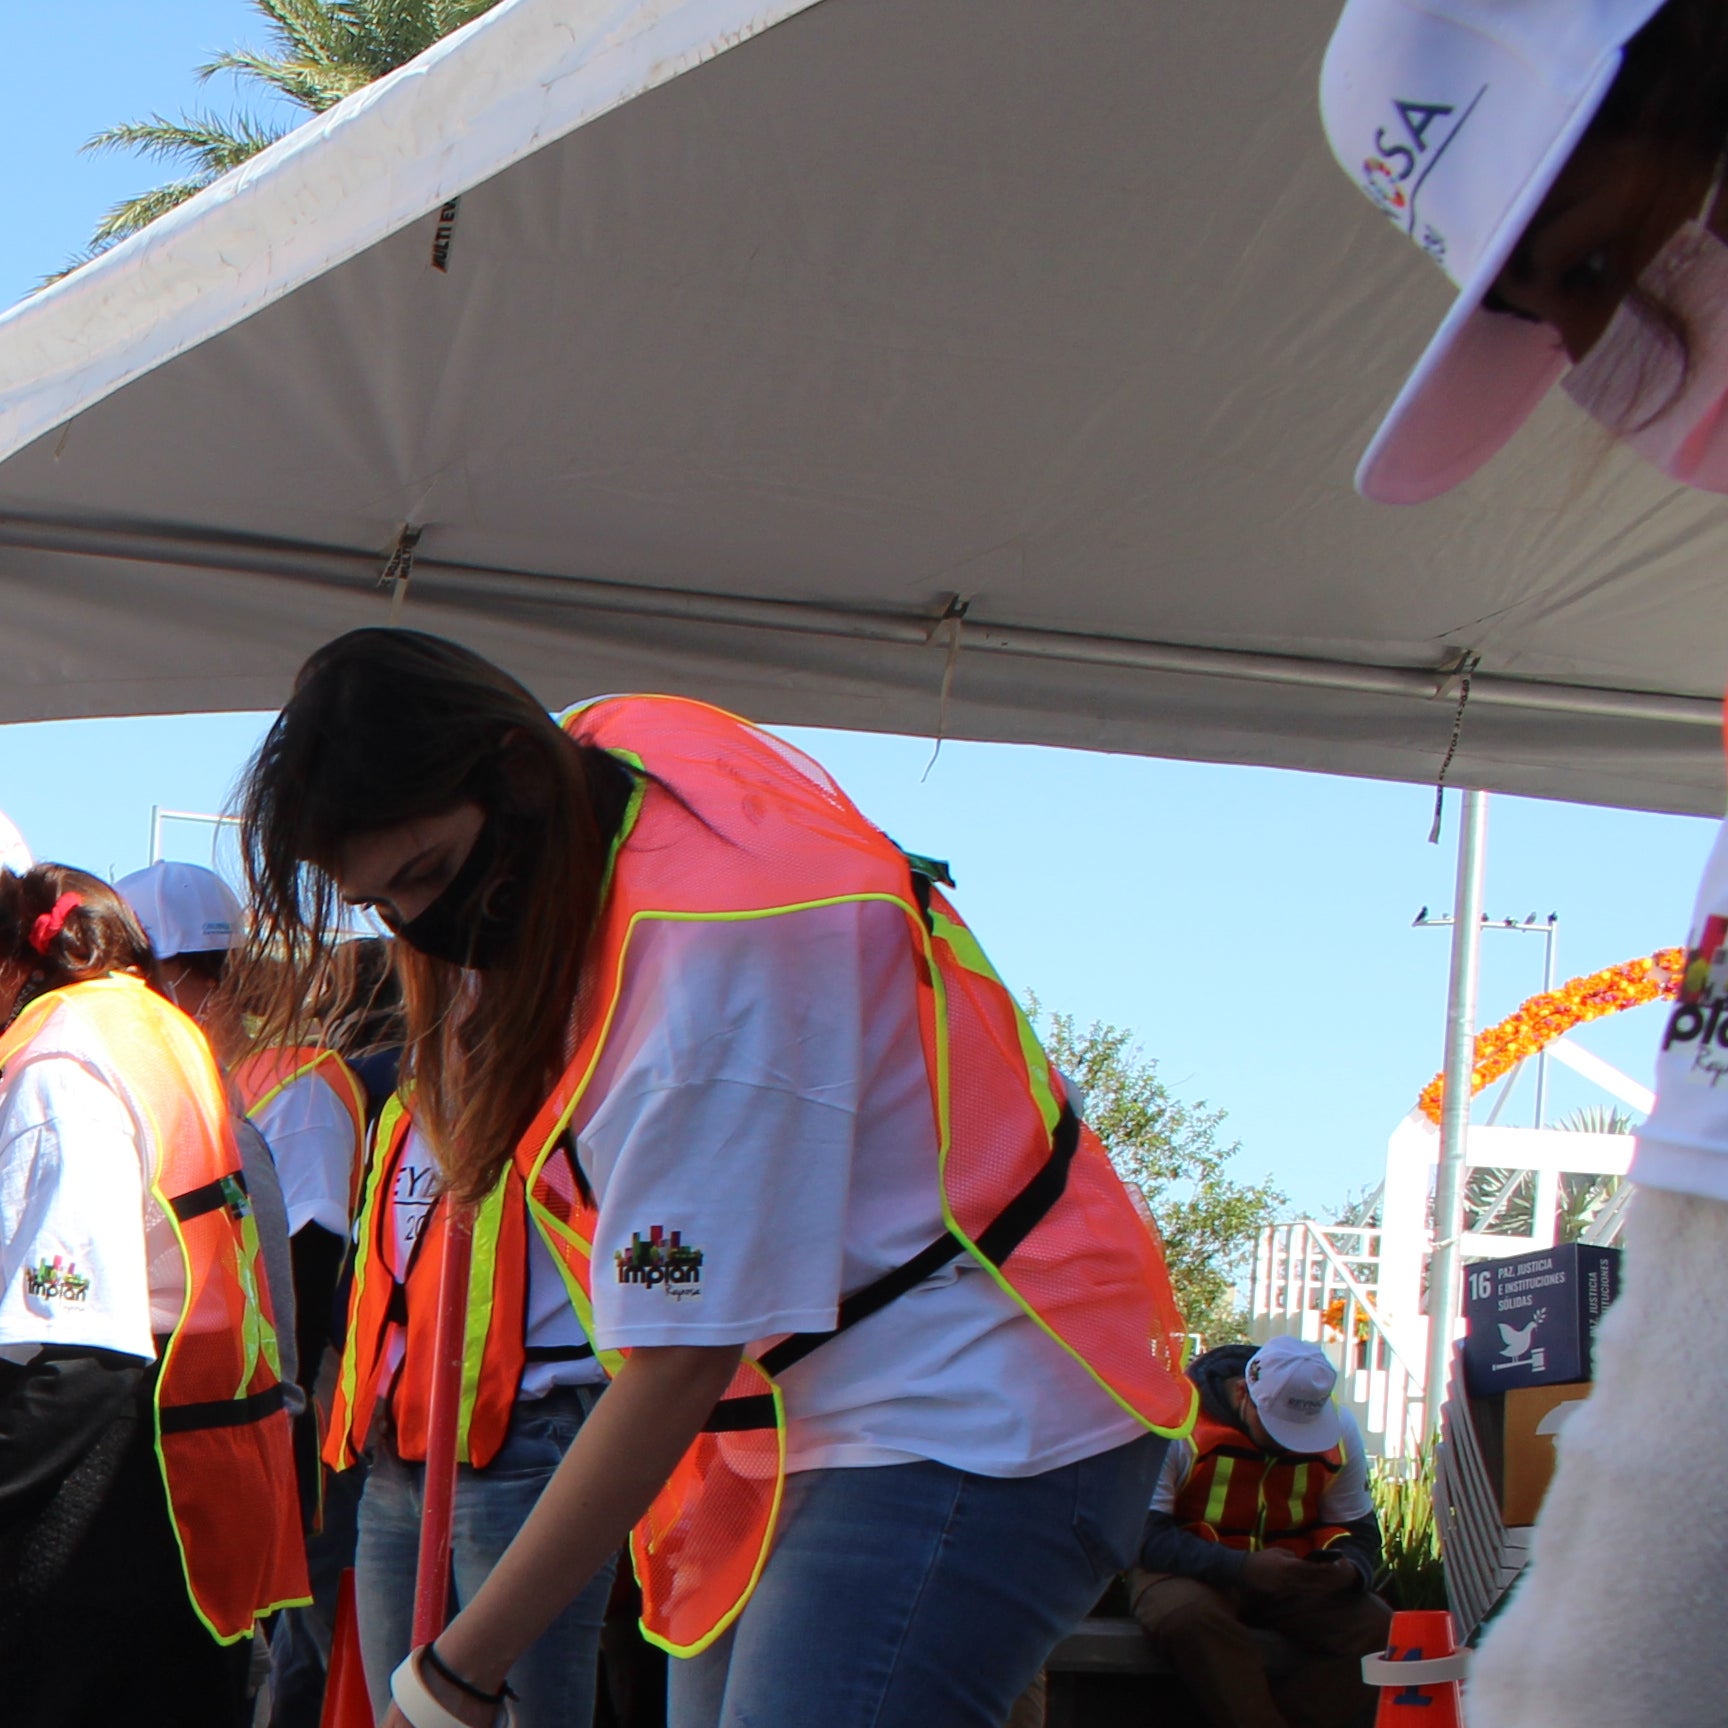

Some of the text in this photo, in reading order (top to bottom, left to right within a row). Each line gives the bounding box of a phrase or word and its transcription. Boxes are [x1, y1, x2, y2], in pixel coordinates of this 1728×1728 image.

[1469, 1270, 1492, 1301] 16
[1516, 1258, 1553, 1278] JUSTICIA
[1497, 1271, 1566, 1296] E INSTITUCIONES
[1497, 1294, 1533, 1312] SÓLIDAS
